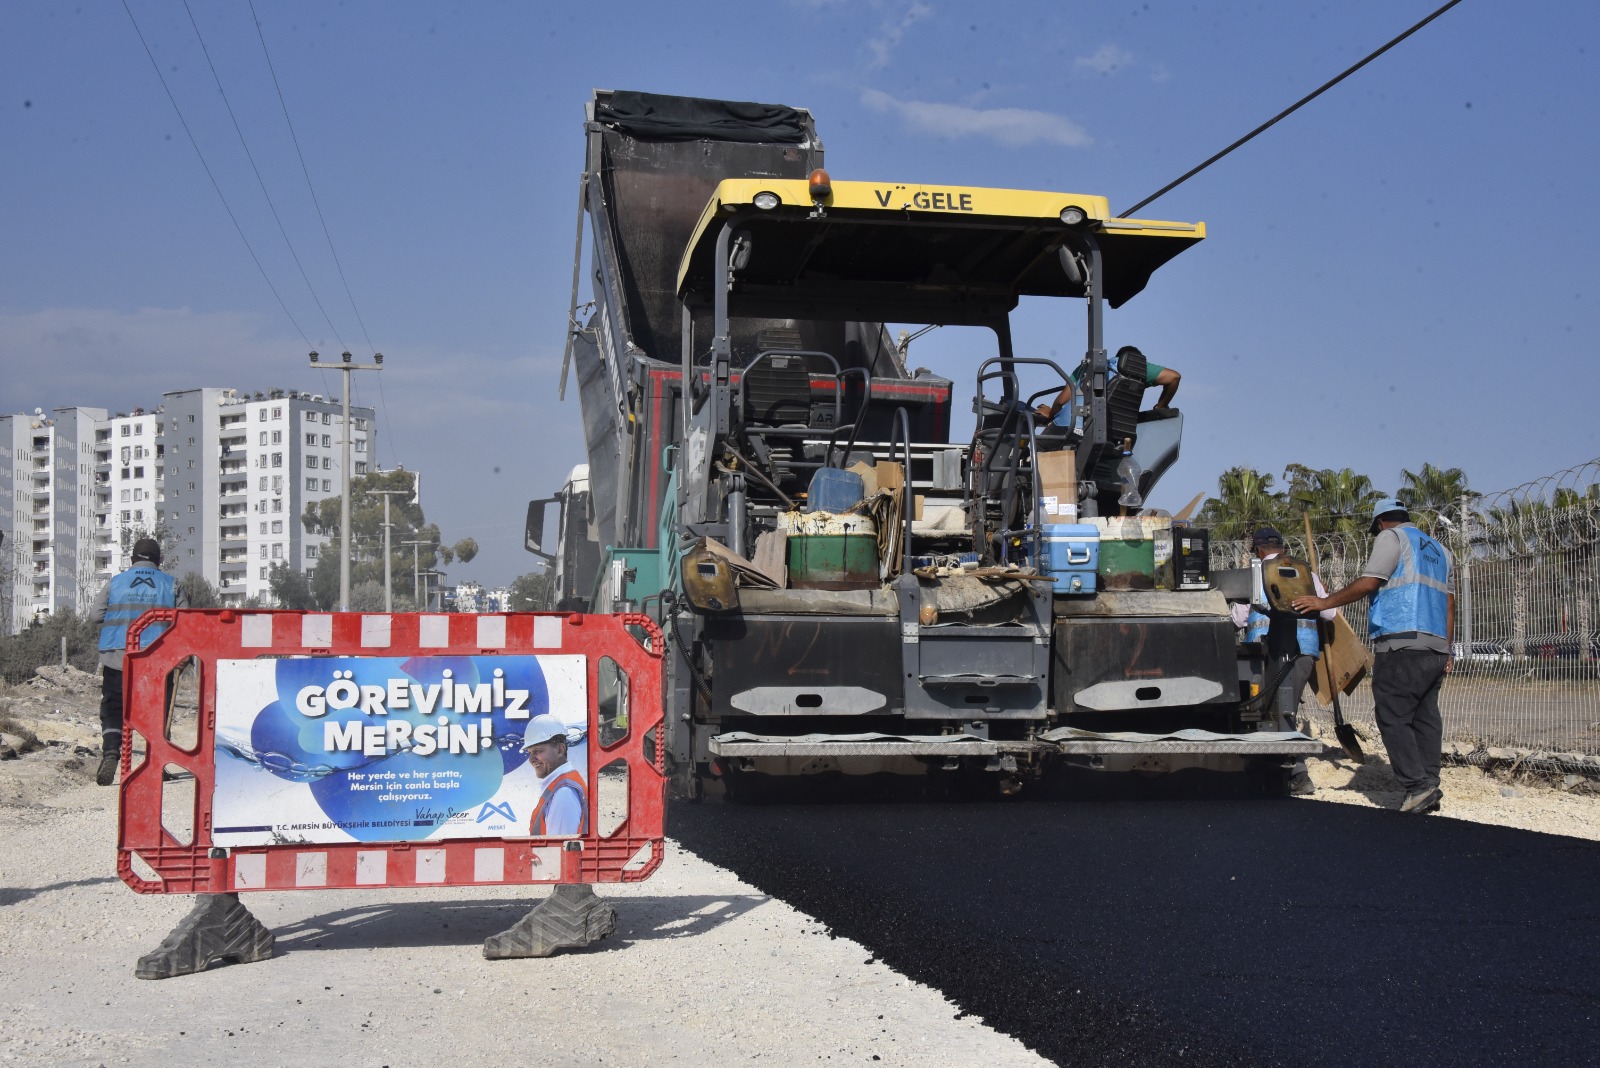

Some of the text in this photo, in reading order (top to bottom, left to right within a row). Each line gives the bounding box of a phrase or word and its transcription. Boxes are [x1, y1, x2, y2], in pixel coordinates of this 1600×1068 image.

[874, 185, 973, 211] VGELE
[295, 668, 530, 719] GÖREVİMİZ
[324, 715, 492, 756] MERSİN!
[347, 772, 366, 781] Her
[368, 770, 396, 782] yerde
[413, 769, 429, 779] her
[431, 770, 463, 780] şartta,
[350, 779, 460, 792] Mersin için canla başla
[378, 791, 433, 803] çalışıyoruz.
[415, 806, 444, 824] Vahap
[276, 818, 411, 831] T.C. MERSİN BÜYÜKŞEHİR BELEDİYESİ
